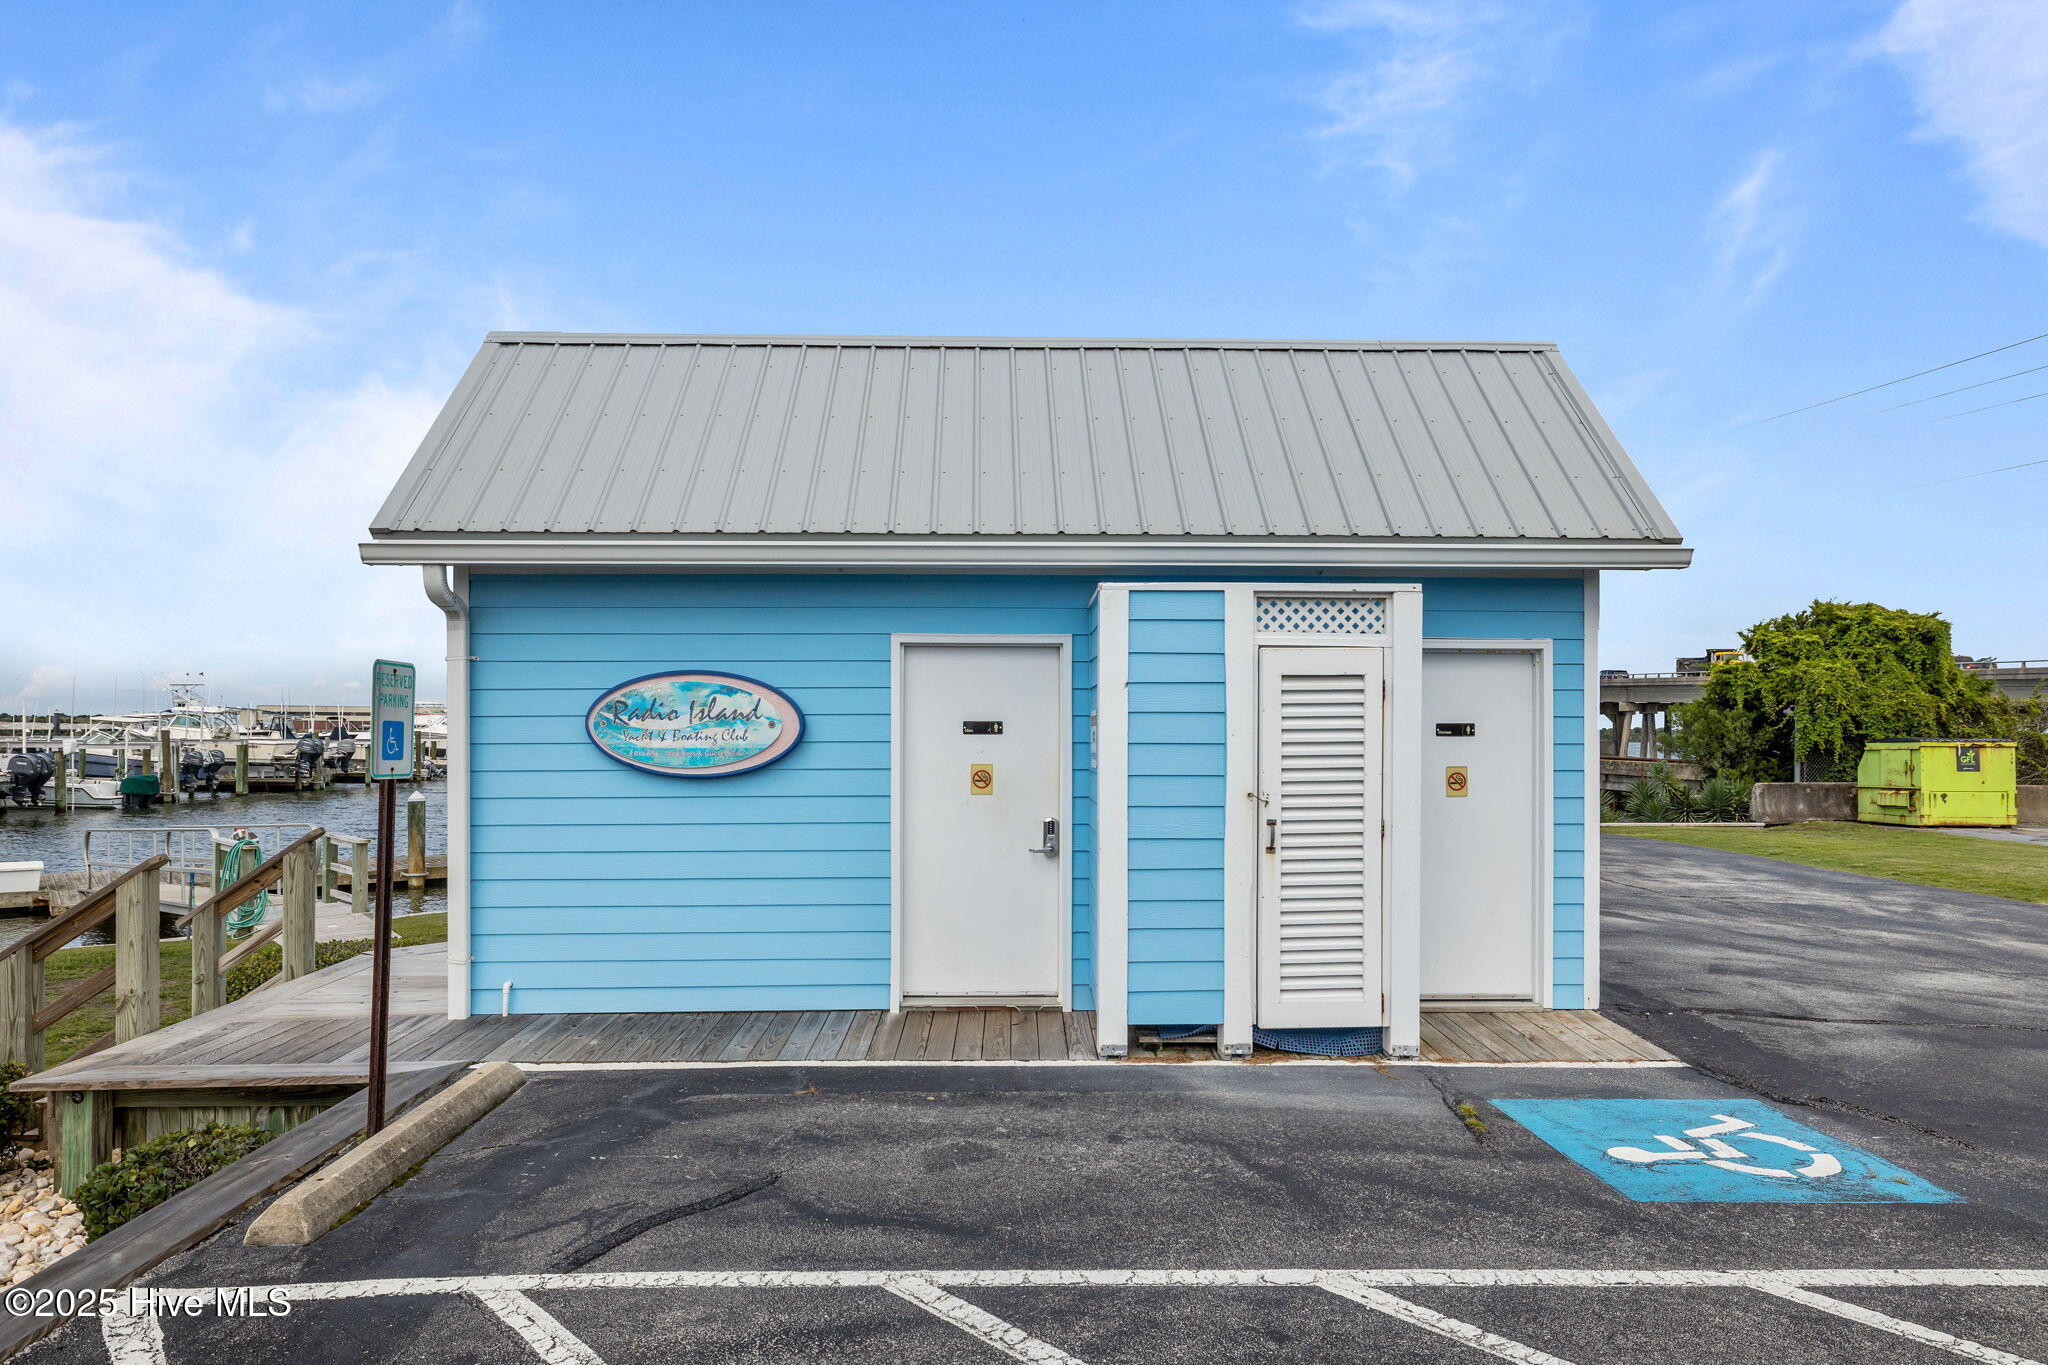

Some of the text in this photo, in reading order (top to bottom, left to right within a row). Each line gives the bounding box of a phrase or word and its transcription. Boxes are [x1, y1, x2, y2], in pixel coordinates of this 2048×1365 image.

[376, 672, 412, 689] RESERVED
[378, 693, 409, 708] PARKING
[613, 696, 763, 726] Radio Island
[622, 728, 749, 746] Yacht & Boating Club
[1960, 755, 1976, 763] GFL
